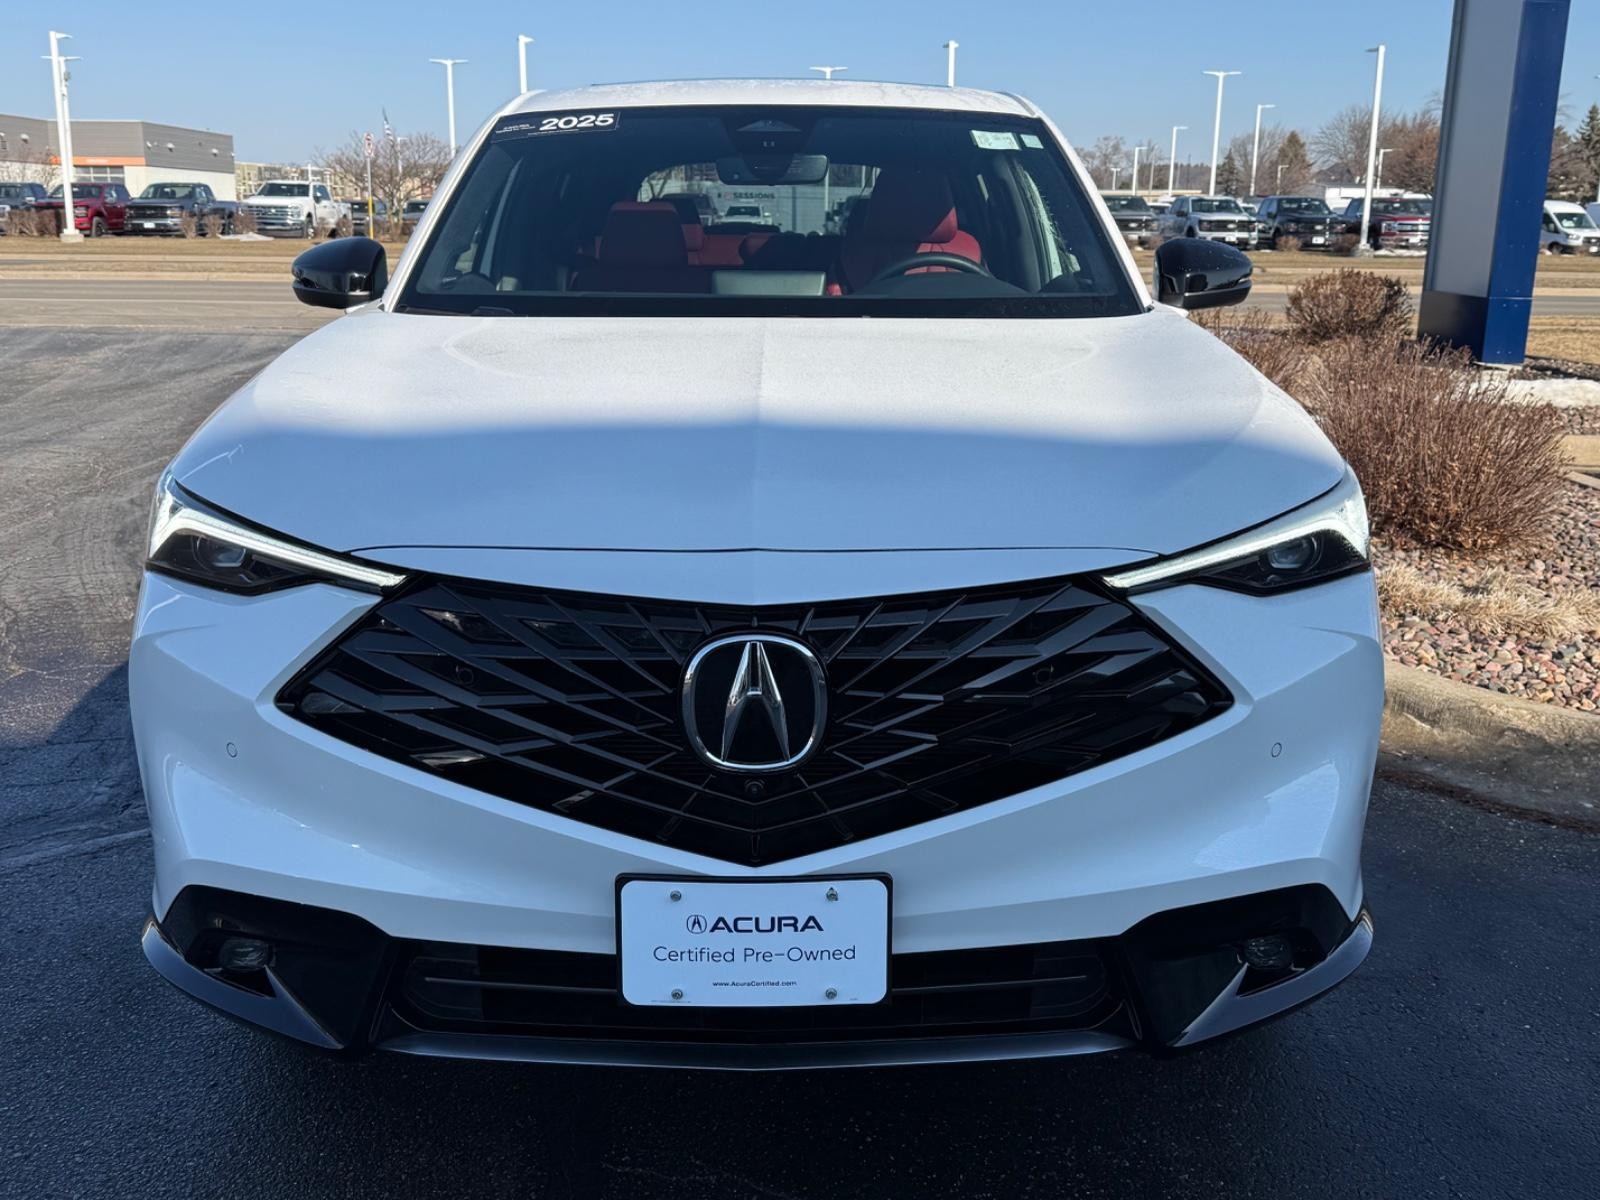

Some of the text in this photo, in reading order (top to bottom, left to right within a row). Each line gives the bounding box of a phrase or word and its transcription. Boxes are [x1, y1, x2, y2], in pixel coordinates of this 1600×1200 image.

[539, 113, 614, 131] 2025
[709, 915, 824, 933] ACURA
[653, 945, 856, 962] Certified Pre-Owned
